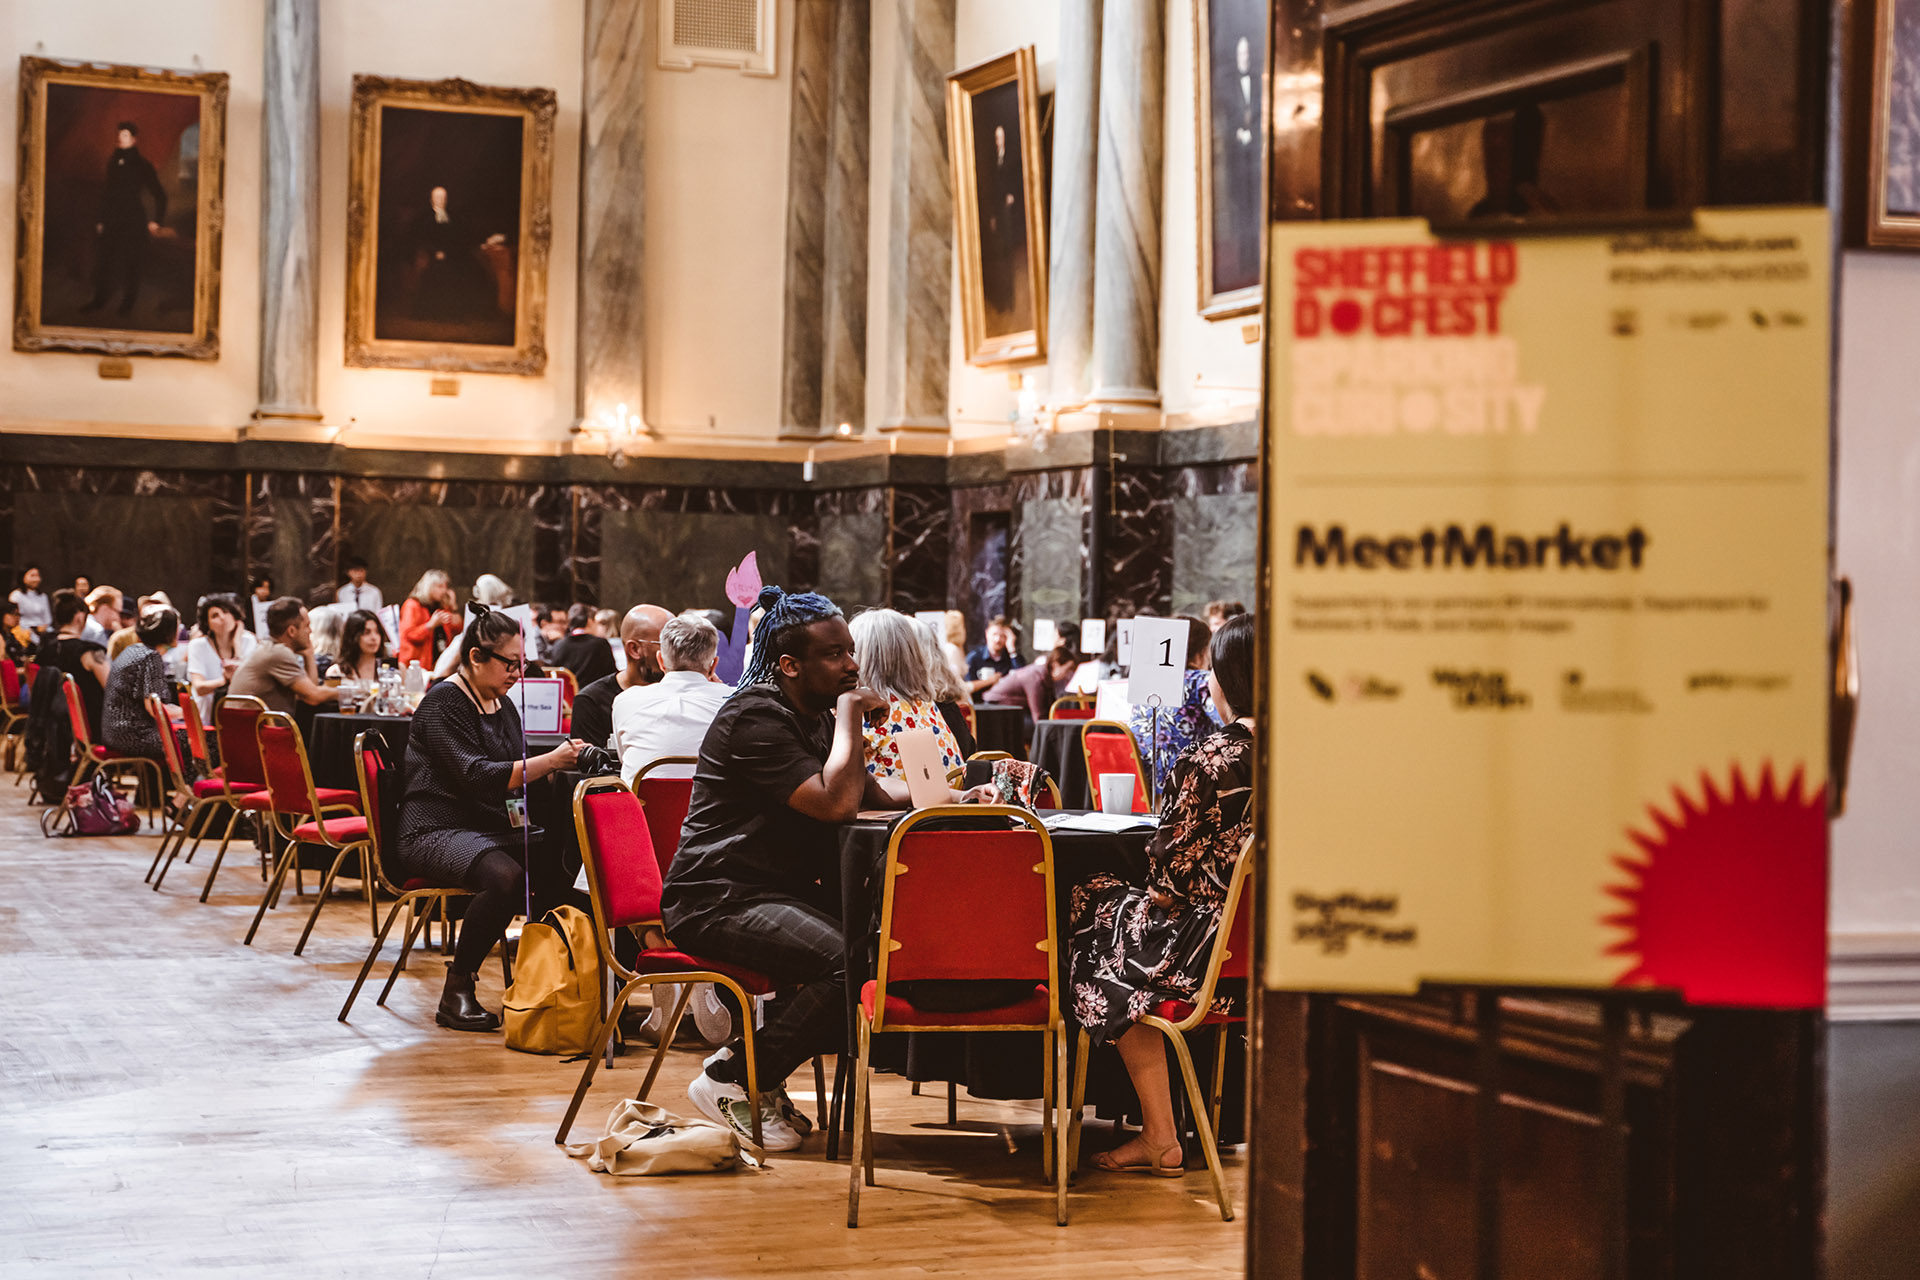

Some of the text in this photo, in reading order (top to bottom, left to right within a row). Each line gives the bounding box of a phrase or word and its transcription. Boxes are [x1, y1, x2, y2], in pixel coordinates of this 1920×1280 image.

[1294, 242, 1516, 289] SHEFFIELD
[1295, 524, 1649, 570] MeetMarket
[1159, 638, 1174, 667] 1
